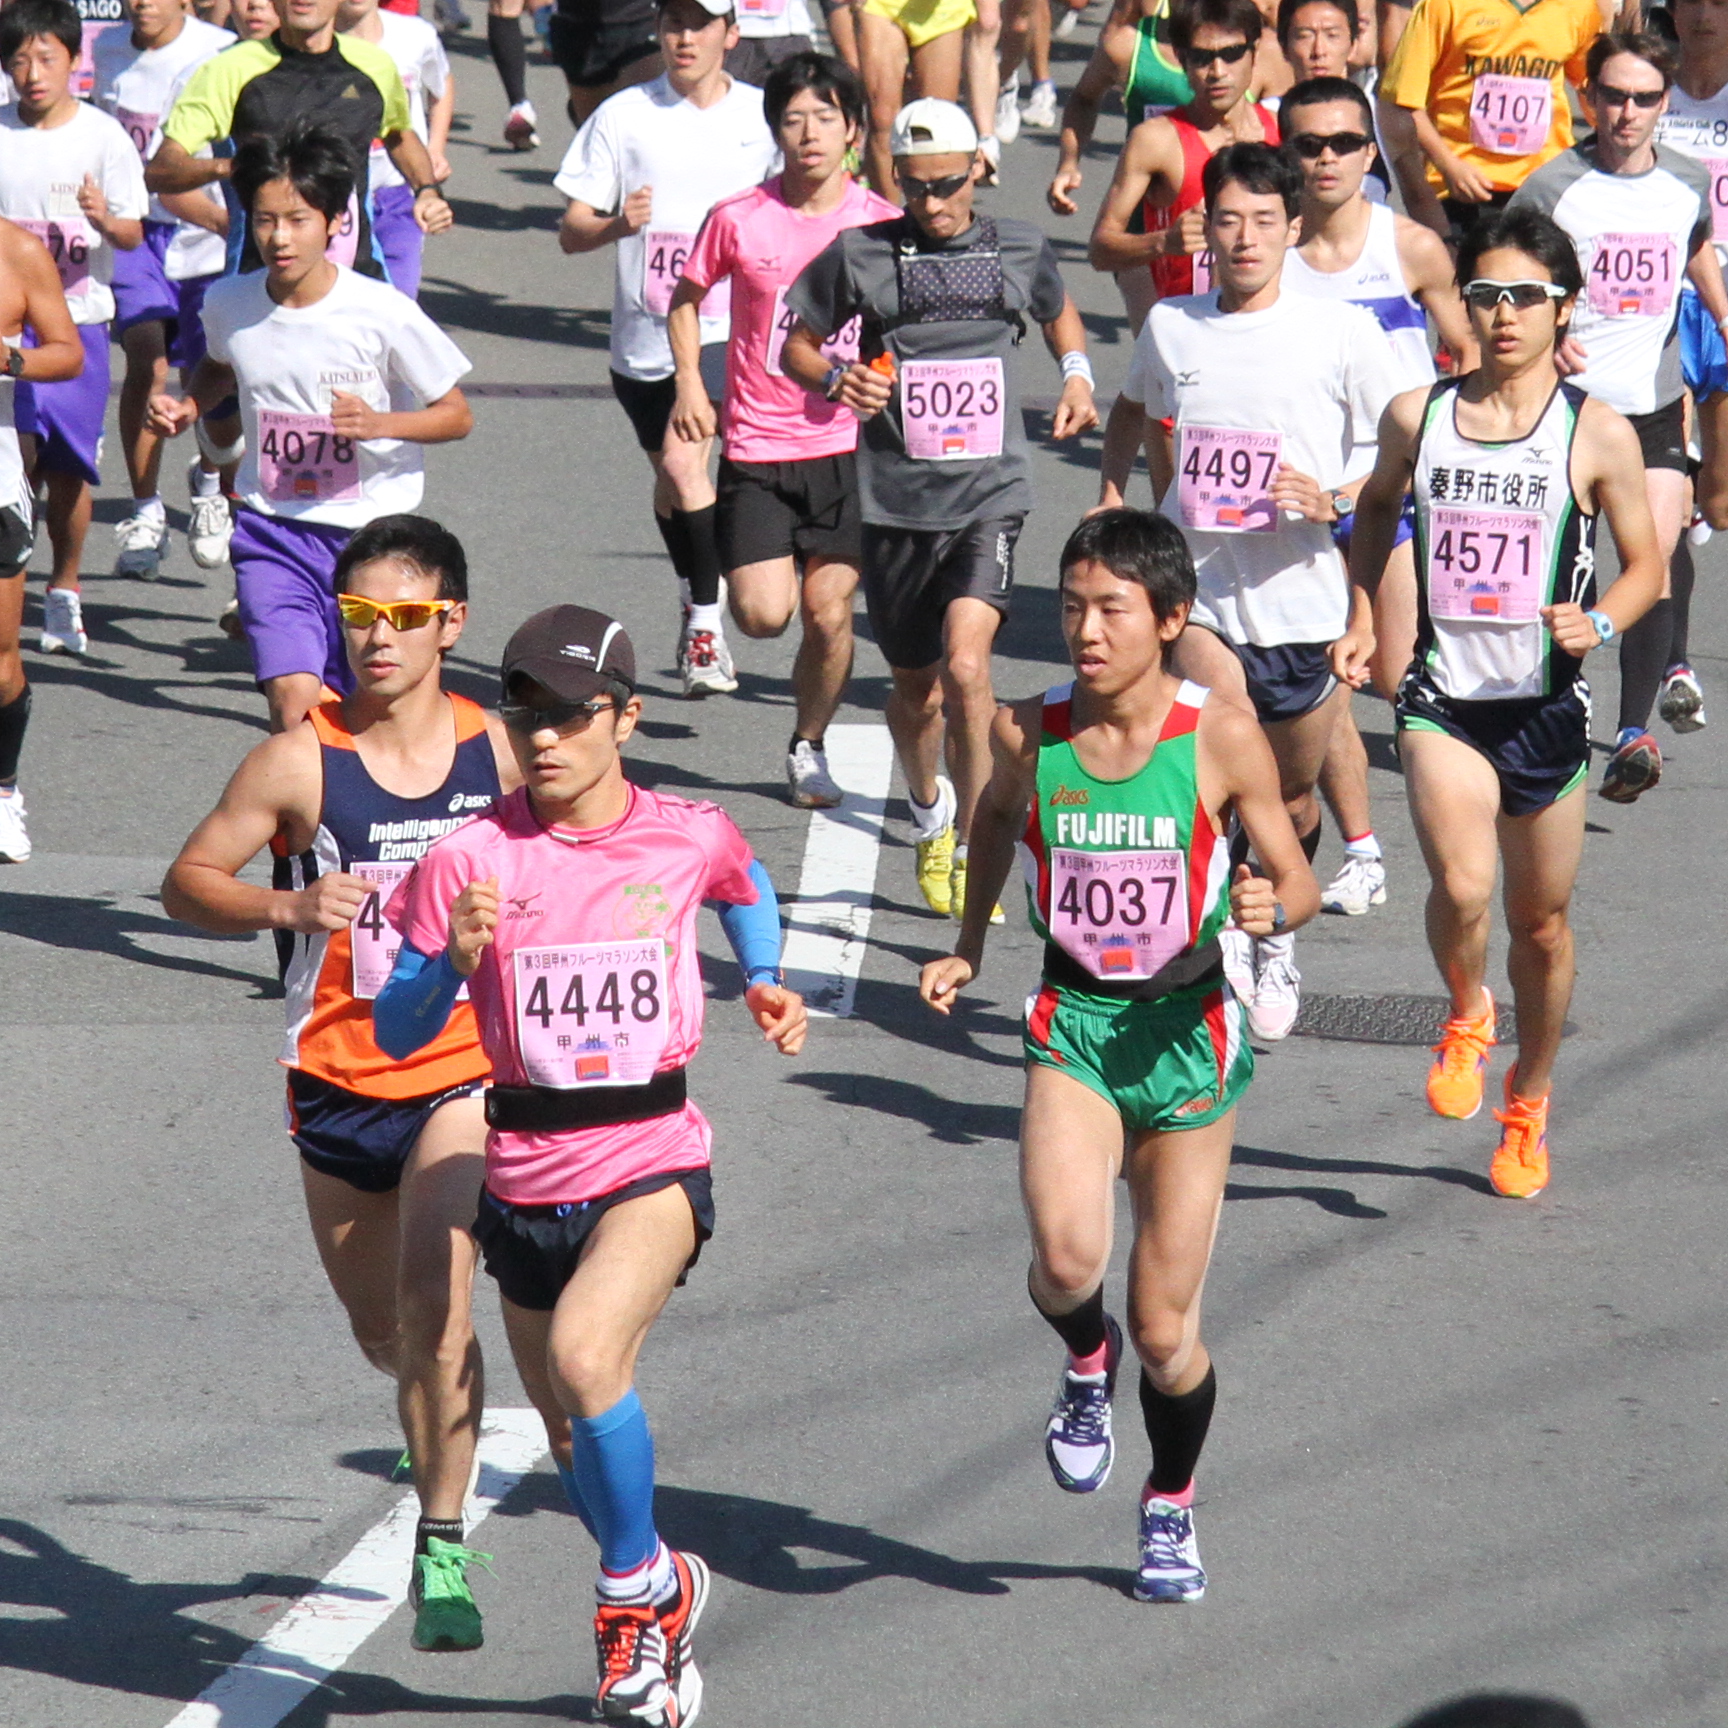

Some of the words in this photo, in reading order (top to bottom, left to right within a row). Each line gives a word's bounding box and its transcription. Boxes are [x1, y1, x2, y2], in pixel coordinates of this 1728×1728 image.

[1475, 91, 1546, 125] 4107
[1592, 247, 1670, 282] 4051
[907, 379, 999, 419] 5023
[262, 427, 354, 465] 4078
[1183, 445, 1277, 490] 4497
[1430, 465, 1549, 510] 秦野市役所
[1434, 529, 1530, 576] 4571
[1057, 812, 1176, 848] FUJIFILM
[1057, 875, 1178, 927] 4037
[1083, 931, 1152, 946] 甲州市
[524, 946, 658, 970] 第3回甲州フルーツマラソン大会
[524, 968, 661, 1029] 4448
[557, 1031, 630, 1051] 甲州市
